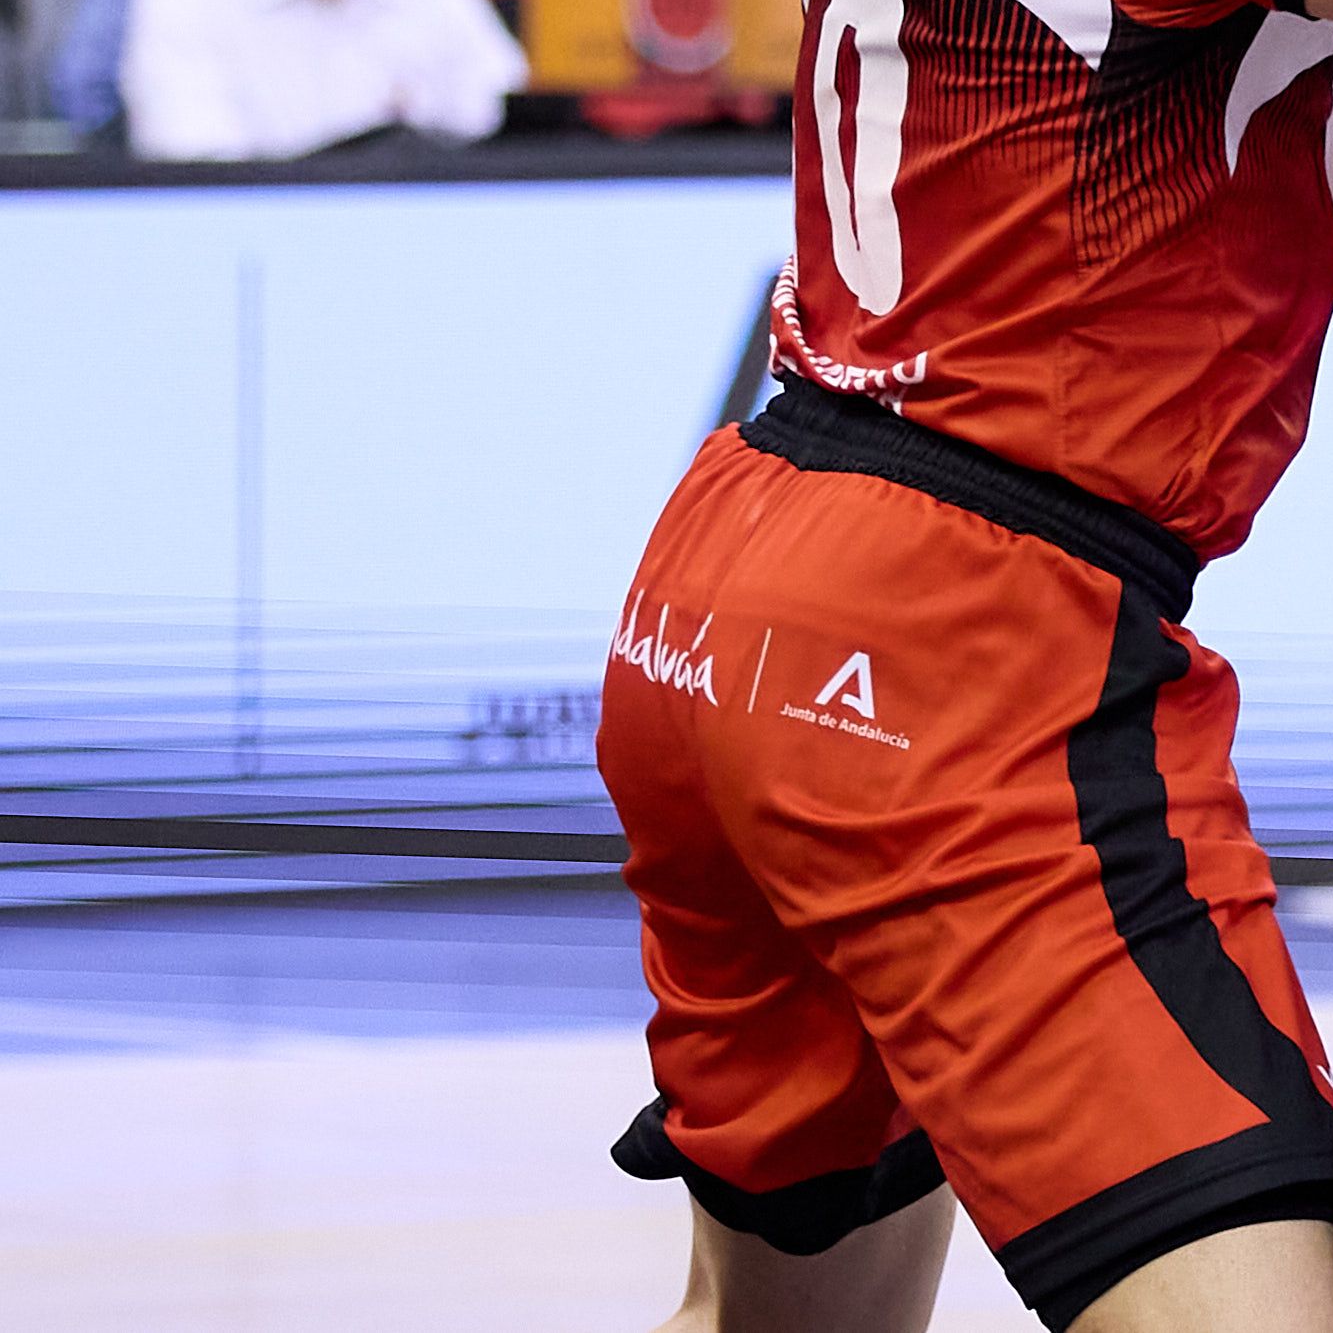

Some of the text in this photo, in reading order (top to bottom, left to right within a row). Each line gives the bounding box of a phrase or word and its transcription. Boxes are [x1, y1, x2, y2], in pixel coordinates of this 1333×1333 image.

[780, 702, 911, 750] Junta de Andalucía
